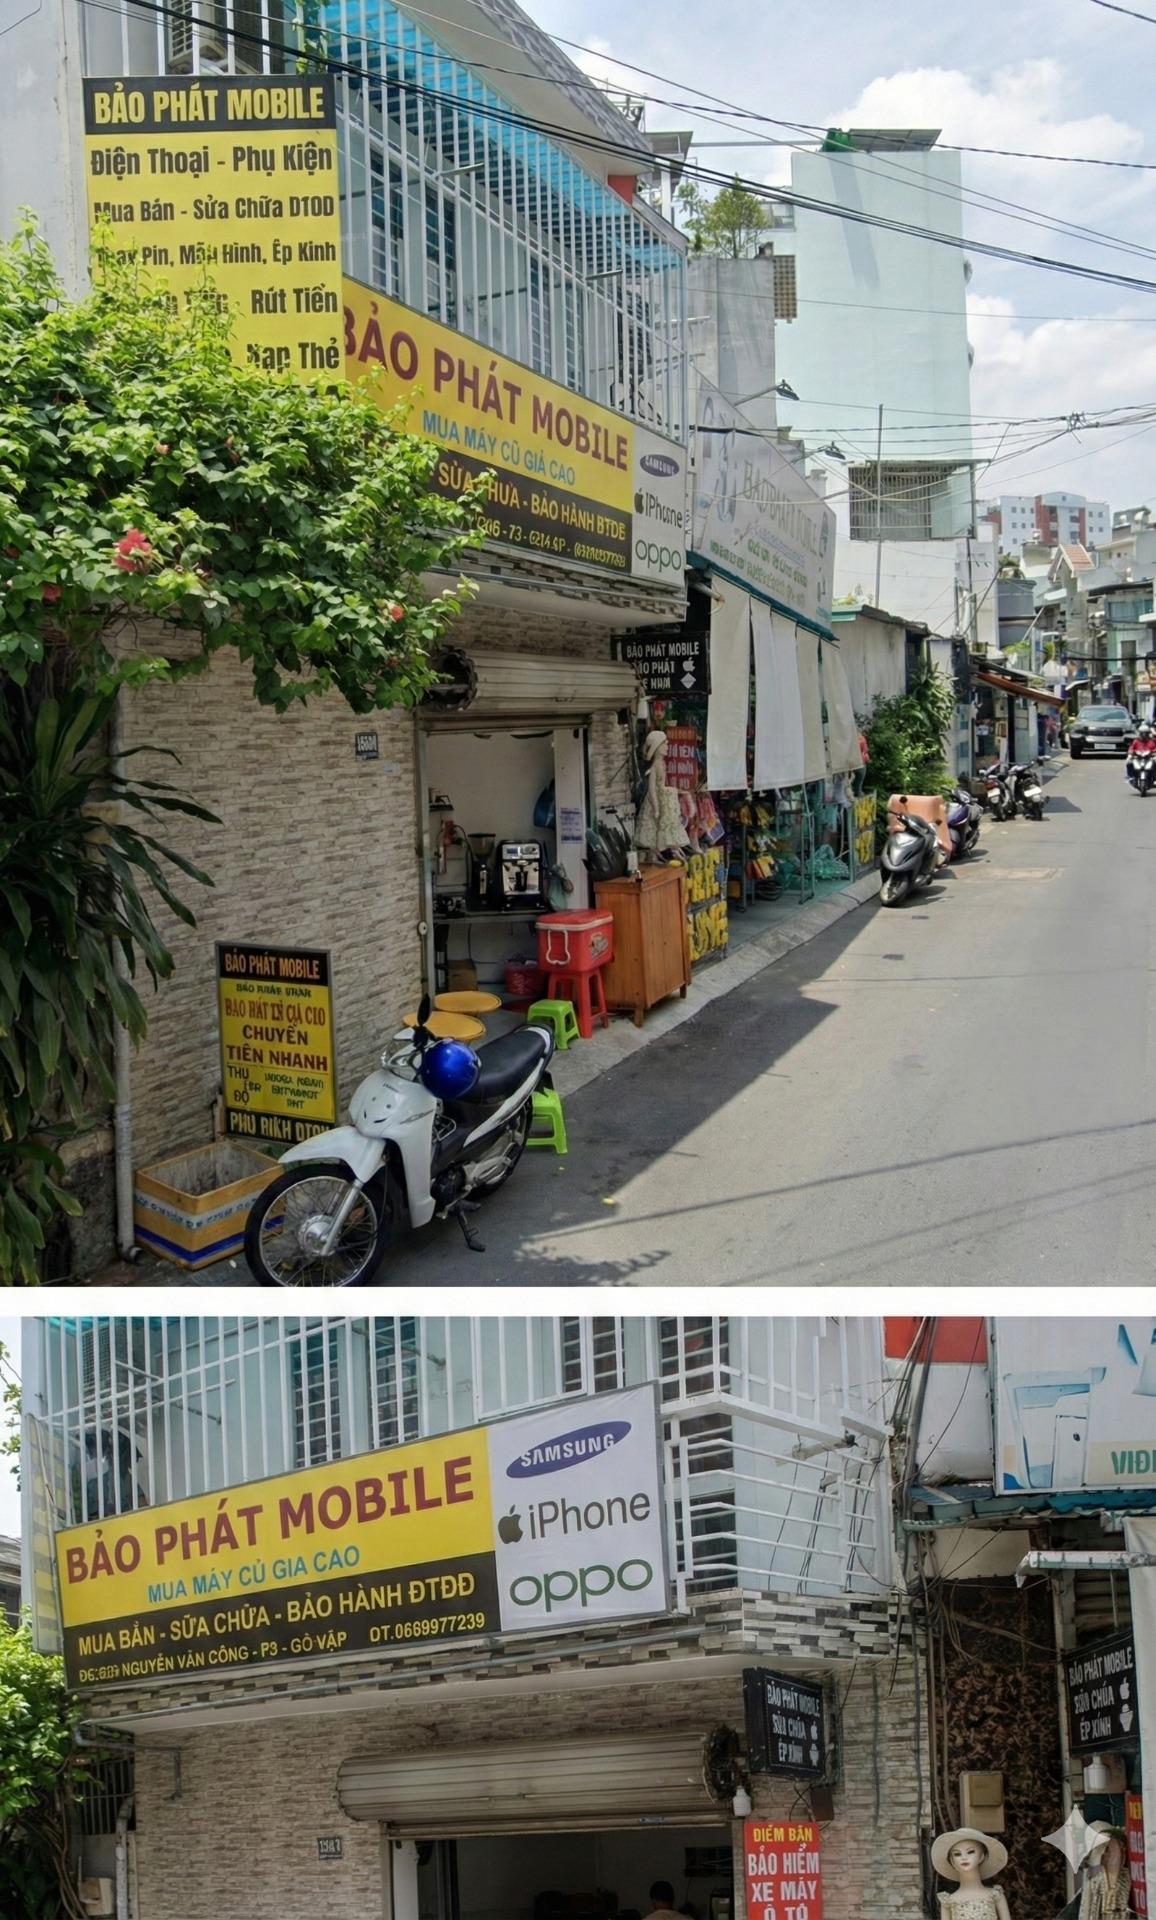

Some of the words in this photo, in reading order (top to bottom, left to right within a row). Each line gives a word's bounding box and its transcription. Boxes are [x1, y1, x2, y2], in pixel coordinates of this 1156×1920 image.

[94, 82, 145, 124] BẢO
[153, 82, 218, 123] PHÁT
[228, 87, 325, 121] MOBILE
[91, 146, 140, 181] Điện
[147, 146, 210, 179] Thoại
[233, 146, 276, 177] Phụ
[283, 141, 332, 176] Kiện
[141, 198, 175, 222] Bán
[193, 194, 229, 221] Sửa
[235, 195, 283, 219] Chữa
[251, 286, 286, 314] Rút
[298, 337, 340, 369] Thẻ
[433, 348, 521, 425] PHÁT
[532, 394, 629, 472] MOBILE
[423, 410, 460, 444] MUA
[464, 427, 497, 456] MÁY
[550, 459, 575, 486] CAO
[531, 489, 558, 521] BẢO
[668, 641, 700, 657] MOBILE
[279, 958, 320, 979] MOBILE
[269, 1050, 328, 1072] NHANH
[520, 1433, 615, 1467] SAMSUNG
[66, 1529, 141, 1584] BẢO
[154, 1498, 263, 1566] PHÁT
[278, 1455, 474, 1540] MOBILE
[529, 1492, 651, 1540] iPhone
[148, 1579, 188, 1604] MUA
[192, 1567, 233, 1595] MÁY
[313, 1545, 360, 1573] CAO
[509, 1558, 653, 1613] oppo
[79, 1632, 116, 1657] MUA
[287, 1592, 333, 1622] BẢO
[339, 1583, 402, 1615] HÀNH
[208, 1644, 249, 1665] CÔNG
[747, 1845, 778, 1877] BẢO
[751, 1882, 774, 1903] XE
[781, 1877, 817, 1901] MÁY
